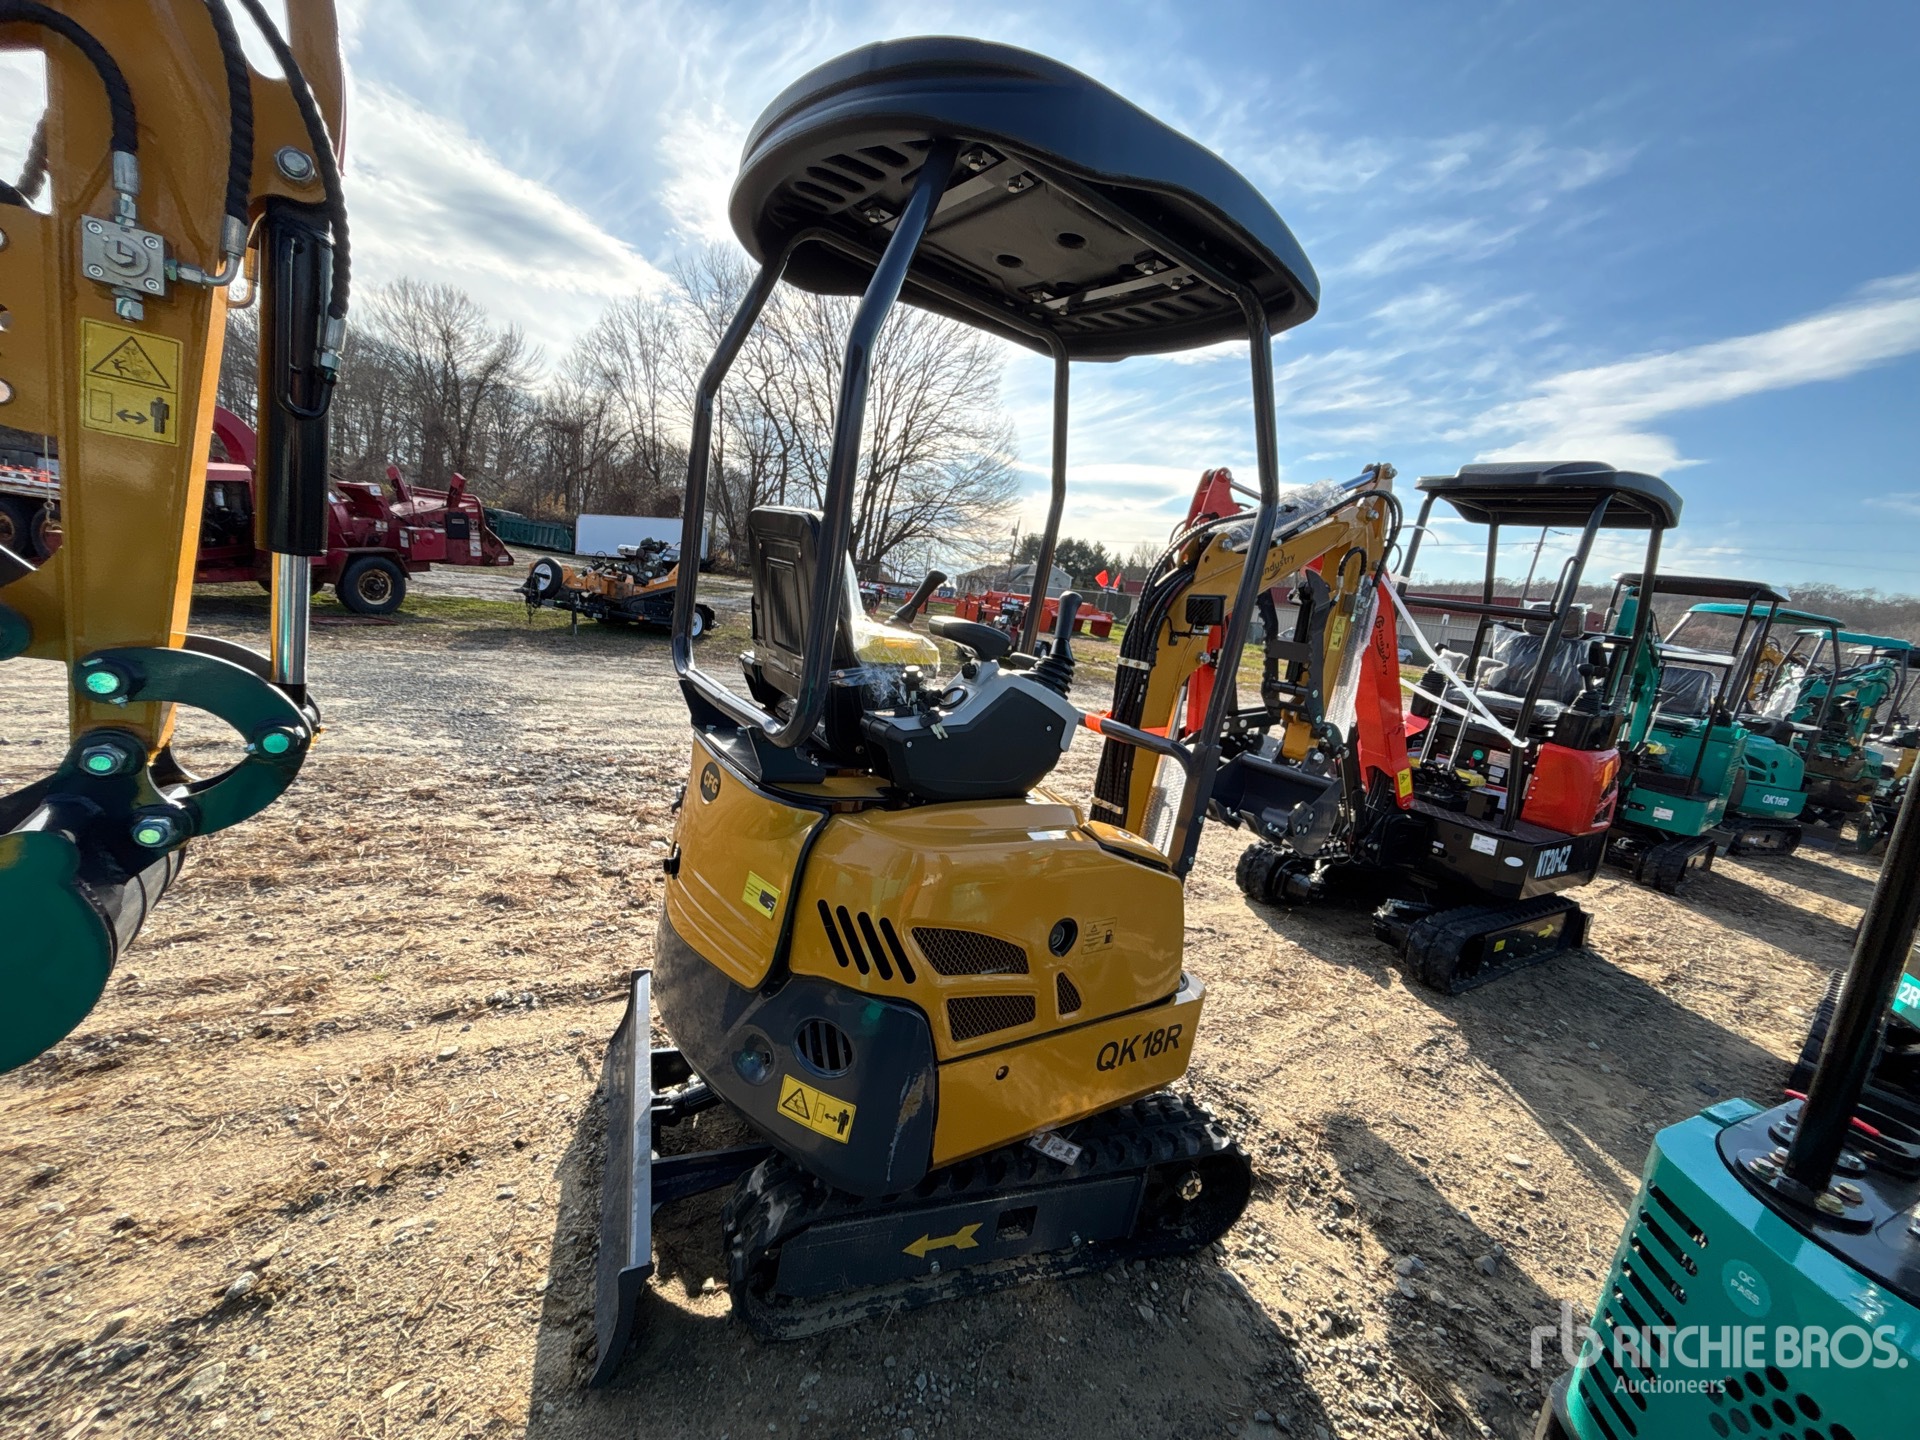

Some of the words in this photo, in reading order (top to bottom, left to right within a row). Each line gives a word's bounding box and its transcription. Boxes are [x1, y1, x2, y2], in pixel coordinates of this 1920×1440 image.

[1264, 553, 1296, 575] ndustry
[703, 770, 719, 794] CFG
[1898, 982, 1920, 1009] 2R
[1738, 1269, 1756, 1288] QC
[1731, 1278, 1760, 1306] PASS
